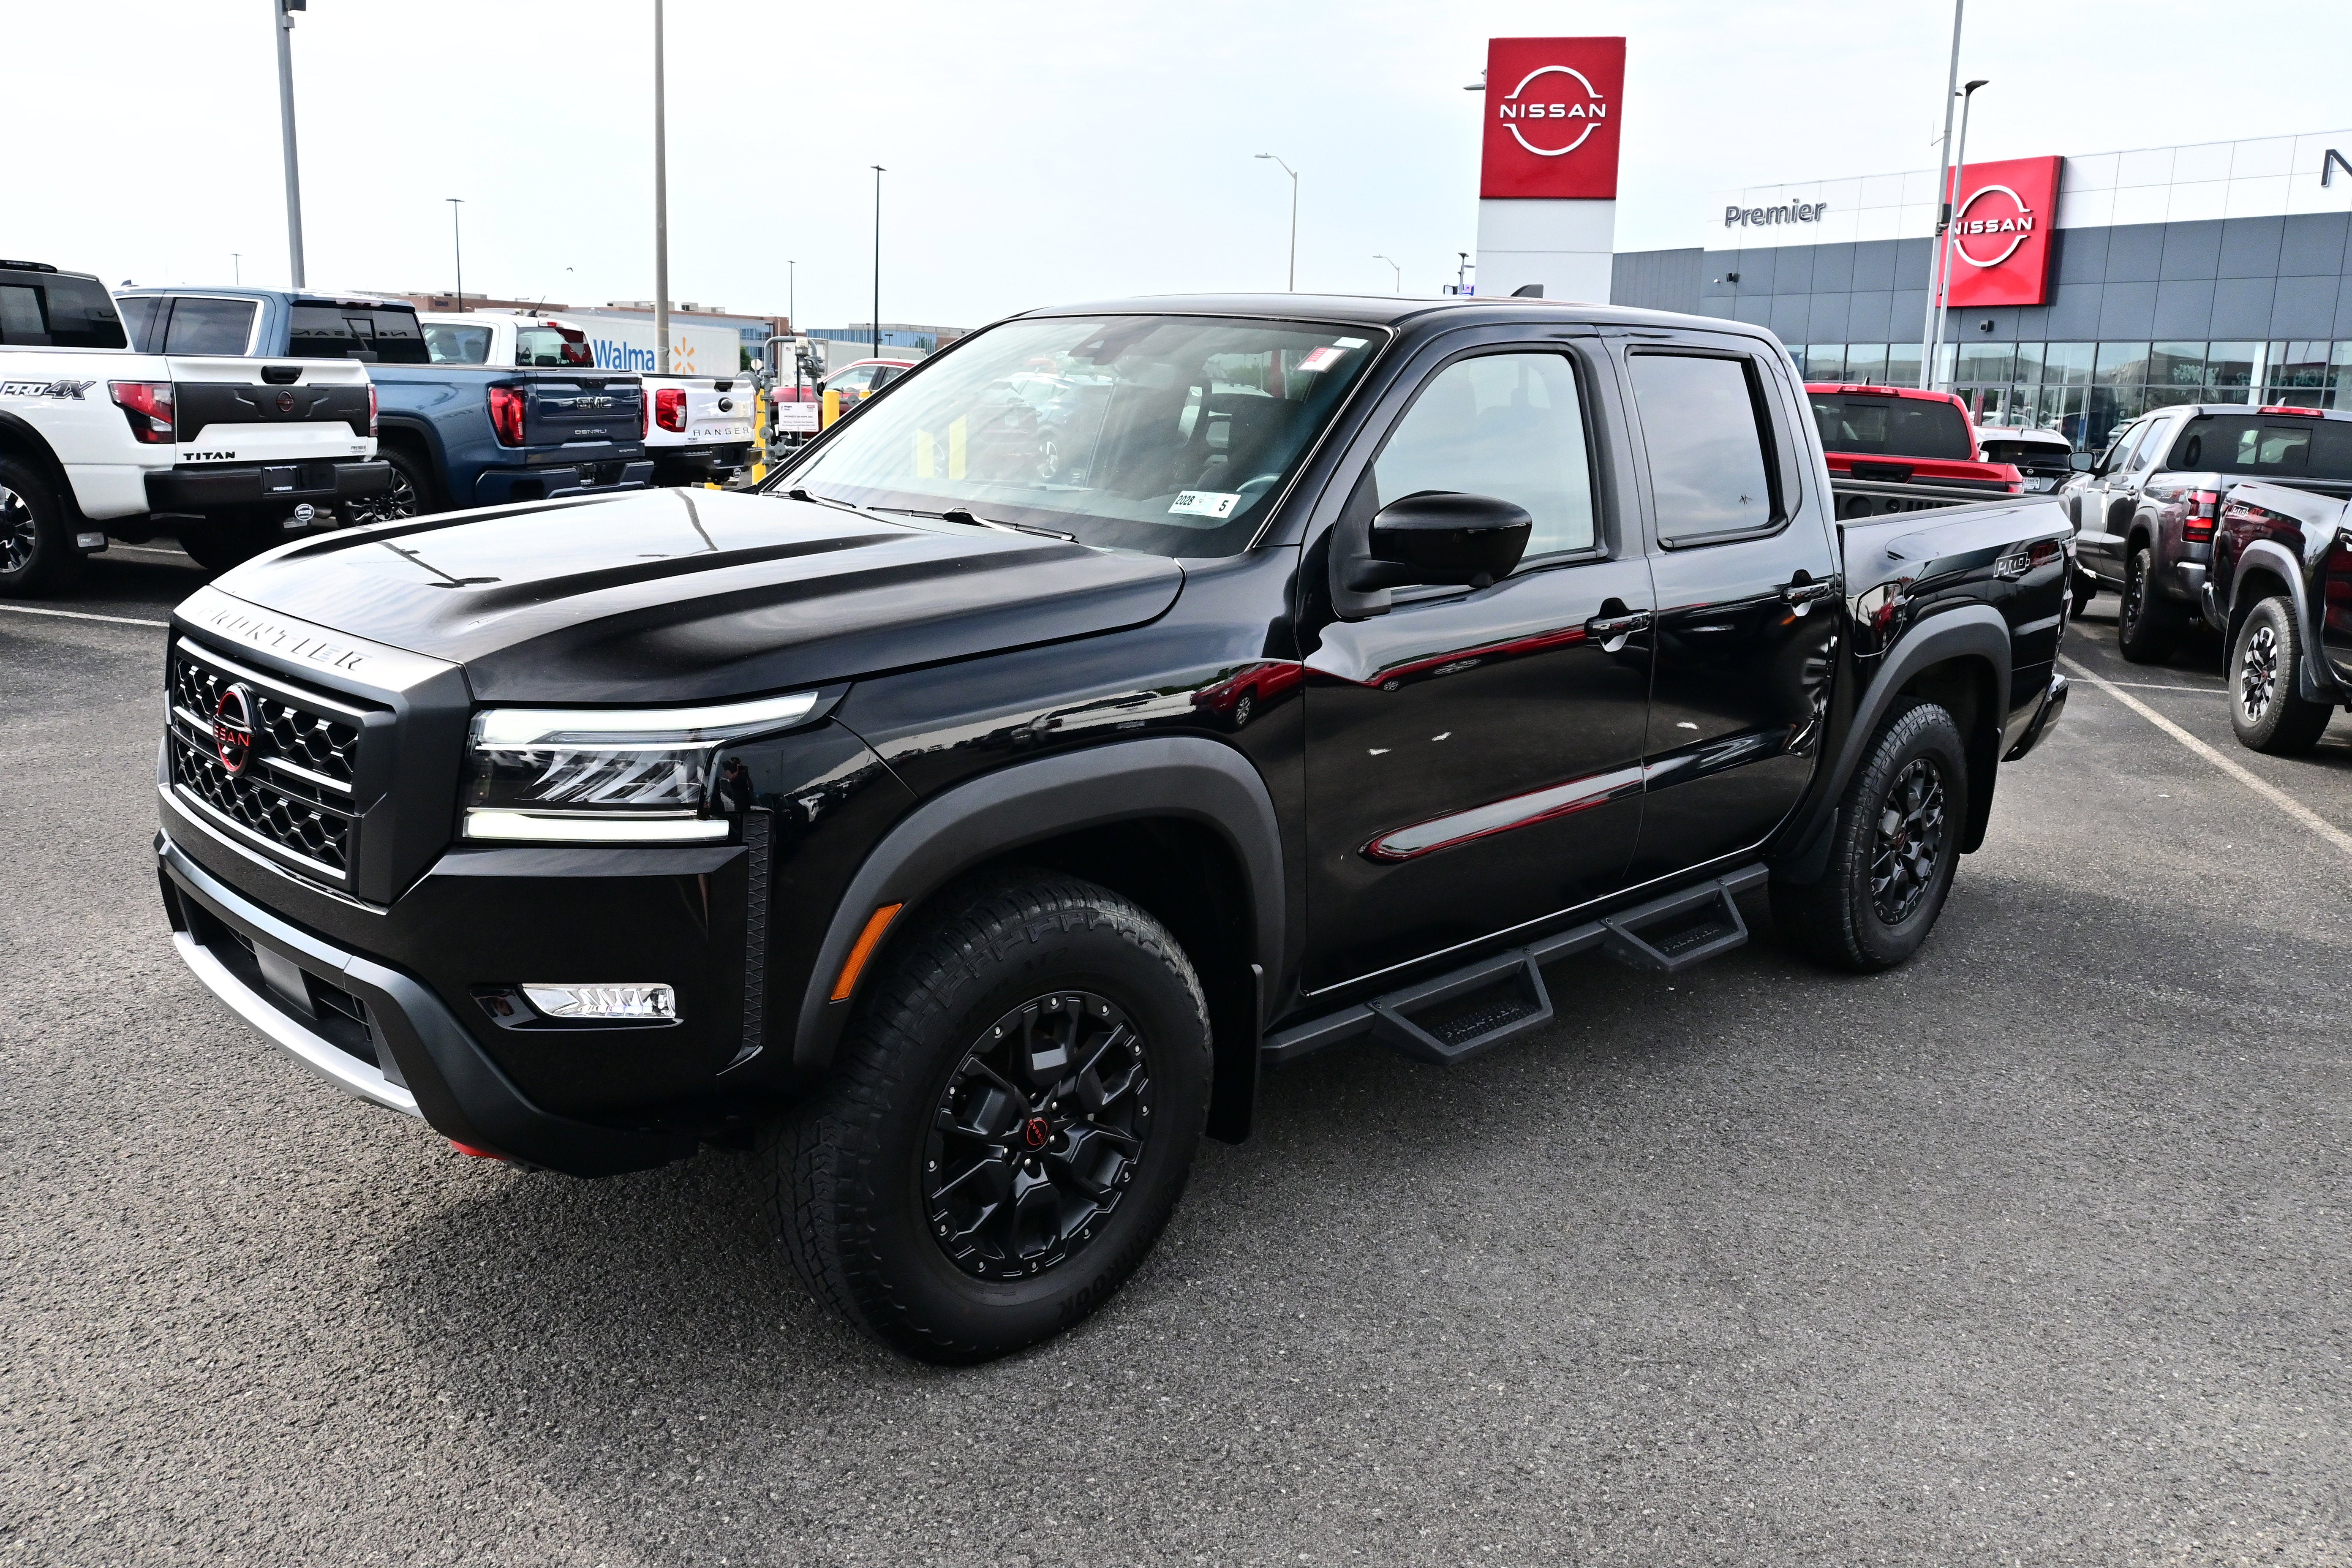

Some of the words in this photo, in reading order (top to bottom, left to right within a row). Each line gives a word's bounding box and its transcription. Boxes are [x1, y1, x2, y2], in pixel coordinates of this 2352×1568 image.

[1500, 103, 1606, 118] NISSAN
[1725, 198, 1826, 228] Premier
[593, 339, 655, 371] Walma
[577, 396, 612, 409] GMC
[693, 427, 749, 436] RANGER
[183, 452, 235, 461] TITAN
[1175, 495, 1195, 506] 2028
[1219, 500, 1229, 512] 5
[198, 607, 373, 672] FRONTIER
